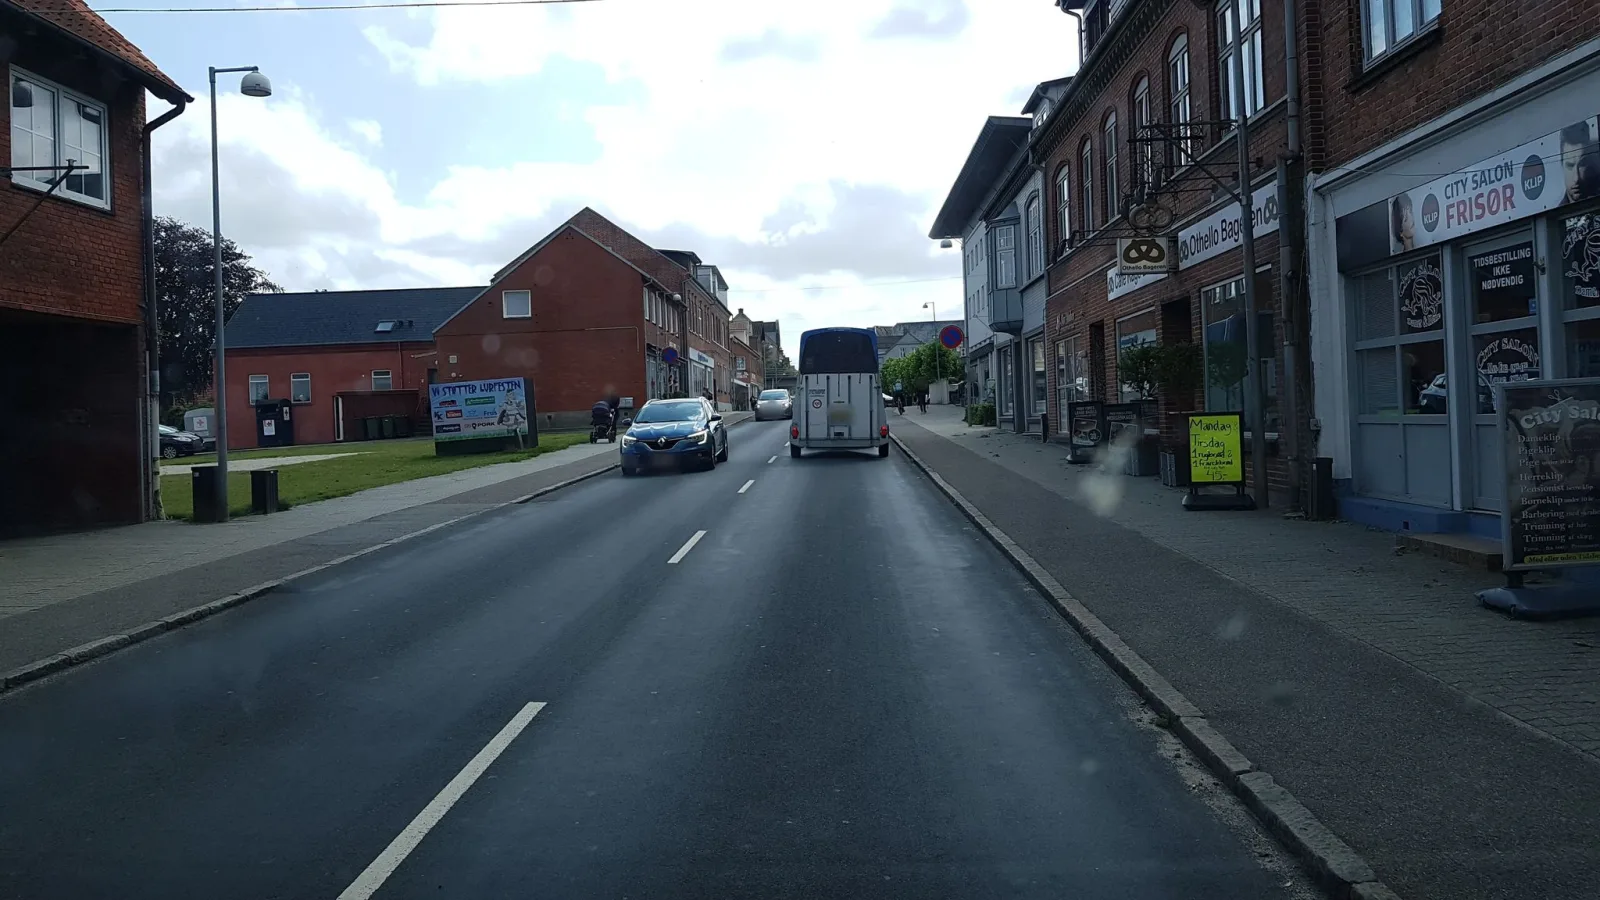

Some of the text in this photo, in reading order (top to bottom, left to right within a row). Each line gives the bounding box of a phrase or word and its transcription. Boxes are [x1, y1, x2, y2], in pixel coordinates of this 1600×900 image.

[1445, 160, 1514, 200] CITY SALON
[1524, 176, 1543, 191] KLIP
[1446, 183, 1516, 229] FRISØR
[1423, 211, 1438, 225] KLIP
[1189, 207, 1262, 256] Othello Bageen
[1473, 247, 1531, 268] TIDSBESTILLING
[1492, 264, 1511, 277] IKKE
[1481, 274, 1524, 291] NØDVENDIG
[1476, 337, 1540, 371] CITY SALON
[443, 384, 477, 397] STØTTER
[1520, 409, 1562, 429] City
[1190, 418, 1232, 436] Mandag
[1191, 433, 1225, 450] Tirsdag
[1517, 433, 1561, 443] Dameklip
[1520, 458, 1540, 468] Pige
[1520, 472, 1563, 481] Herreklip
[1521, 483, 1565, 493] Pensionist
[1521, 509, 1565, 519] Barbering
[1522, 521, 1566, 531] Trimning
[1522, 533, 1566, 543] Trimning
